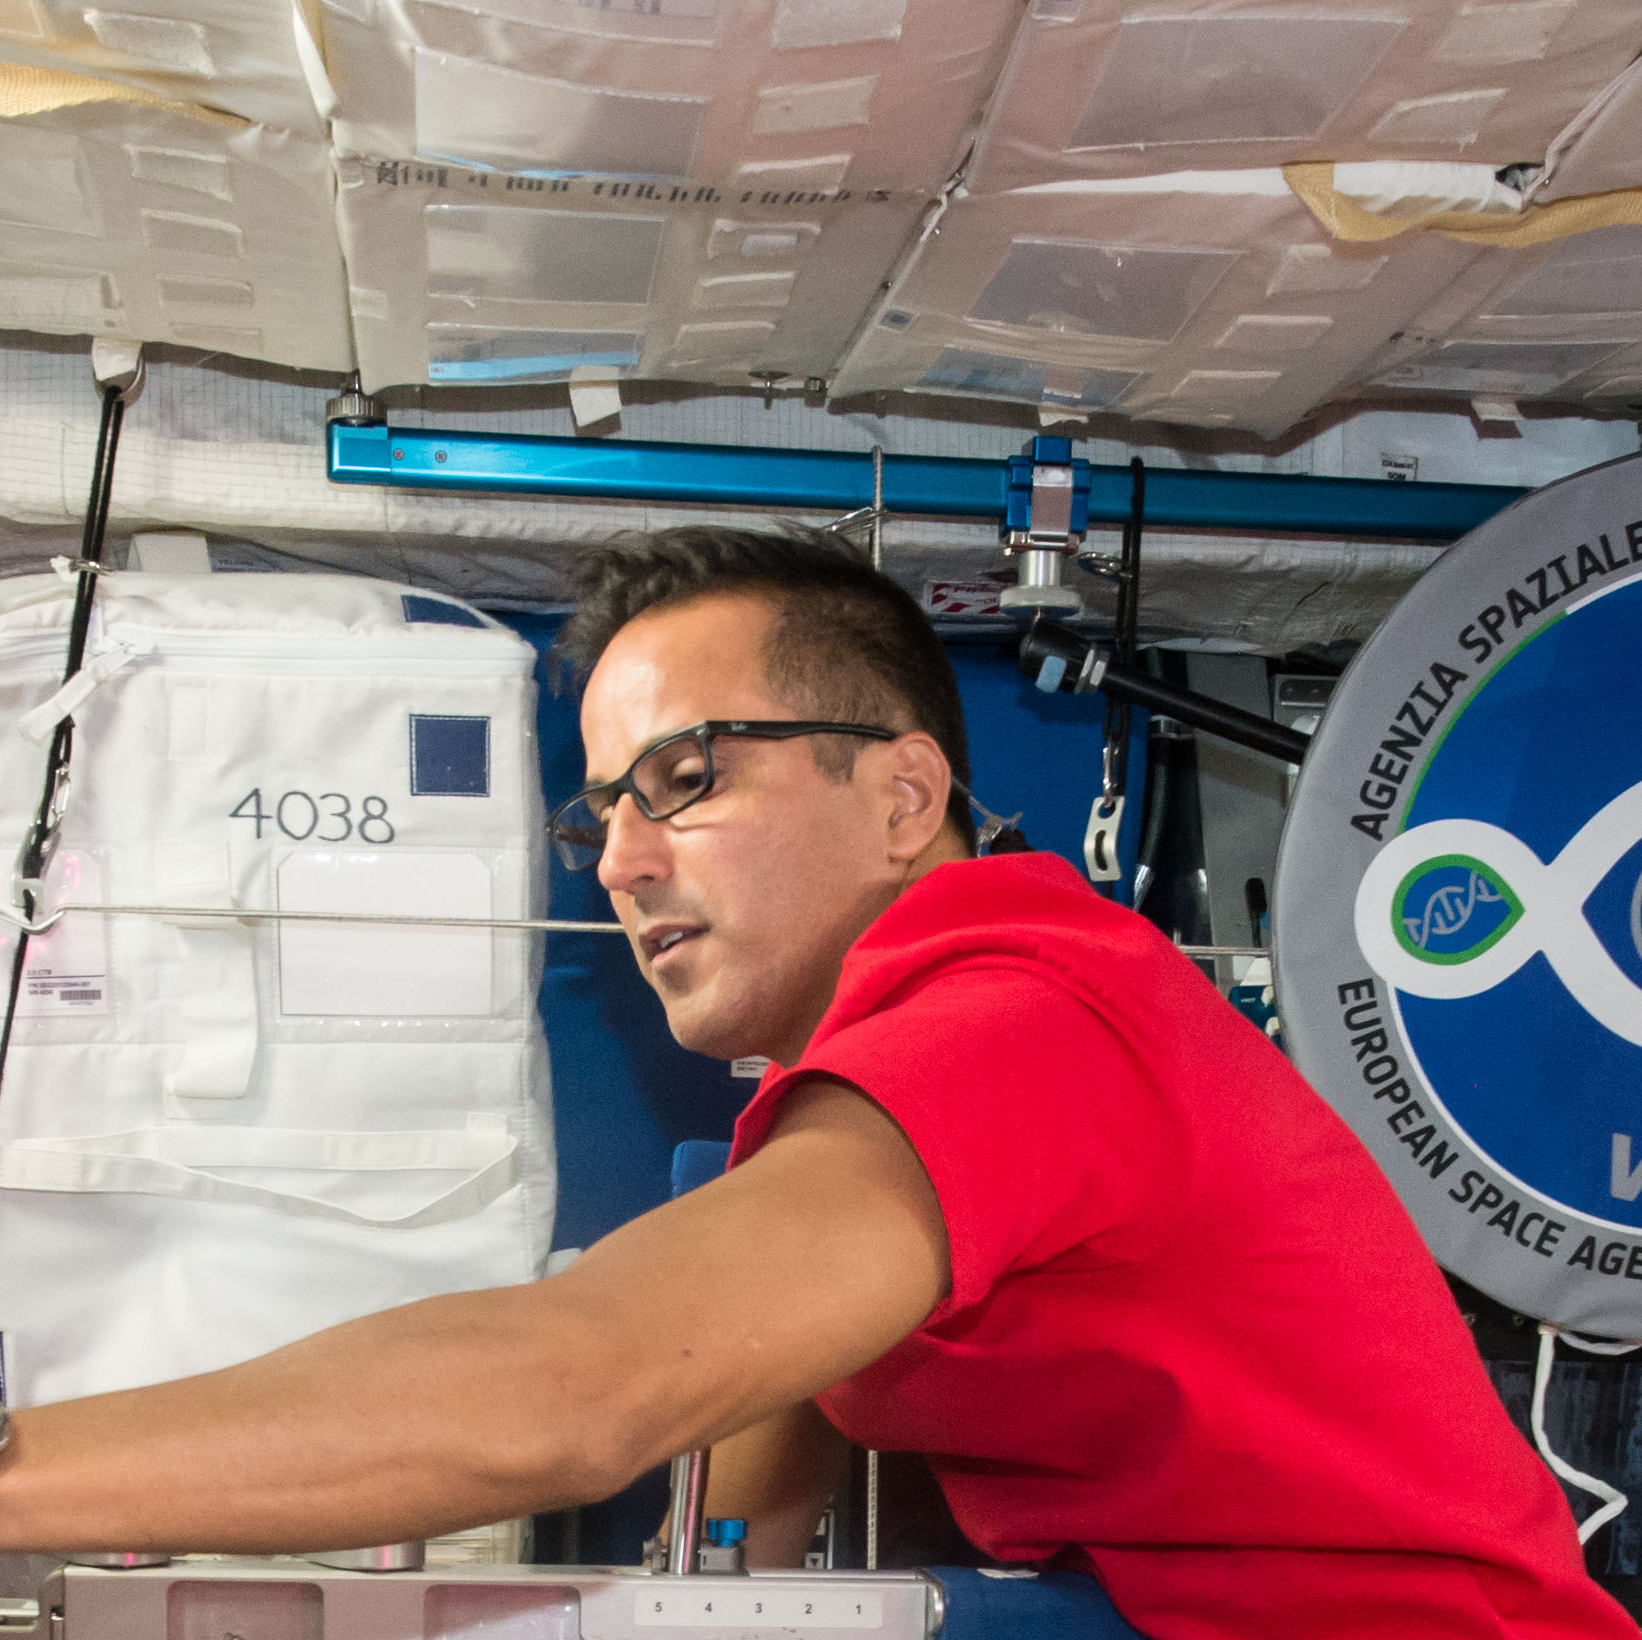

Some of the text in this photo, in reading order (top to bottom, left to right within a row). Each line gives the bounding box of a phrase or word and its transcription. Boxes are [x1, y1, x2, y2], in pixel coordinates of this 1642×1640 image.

[1352, 664, 1468, 841] AGENZIA
[229, 787, 396, 845] 4038
[1337, 978, 1452, 1180] EUROPEAN
[1448, 1169, 1566, 1258] SPACE
[653, 1602, 862, 1615] 5 4 3 2 1
